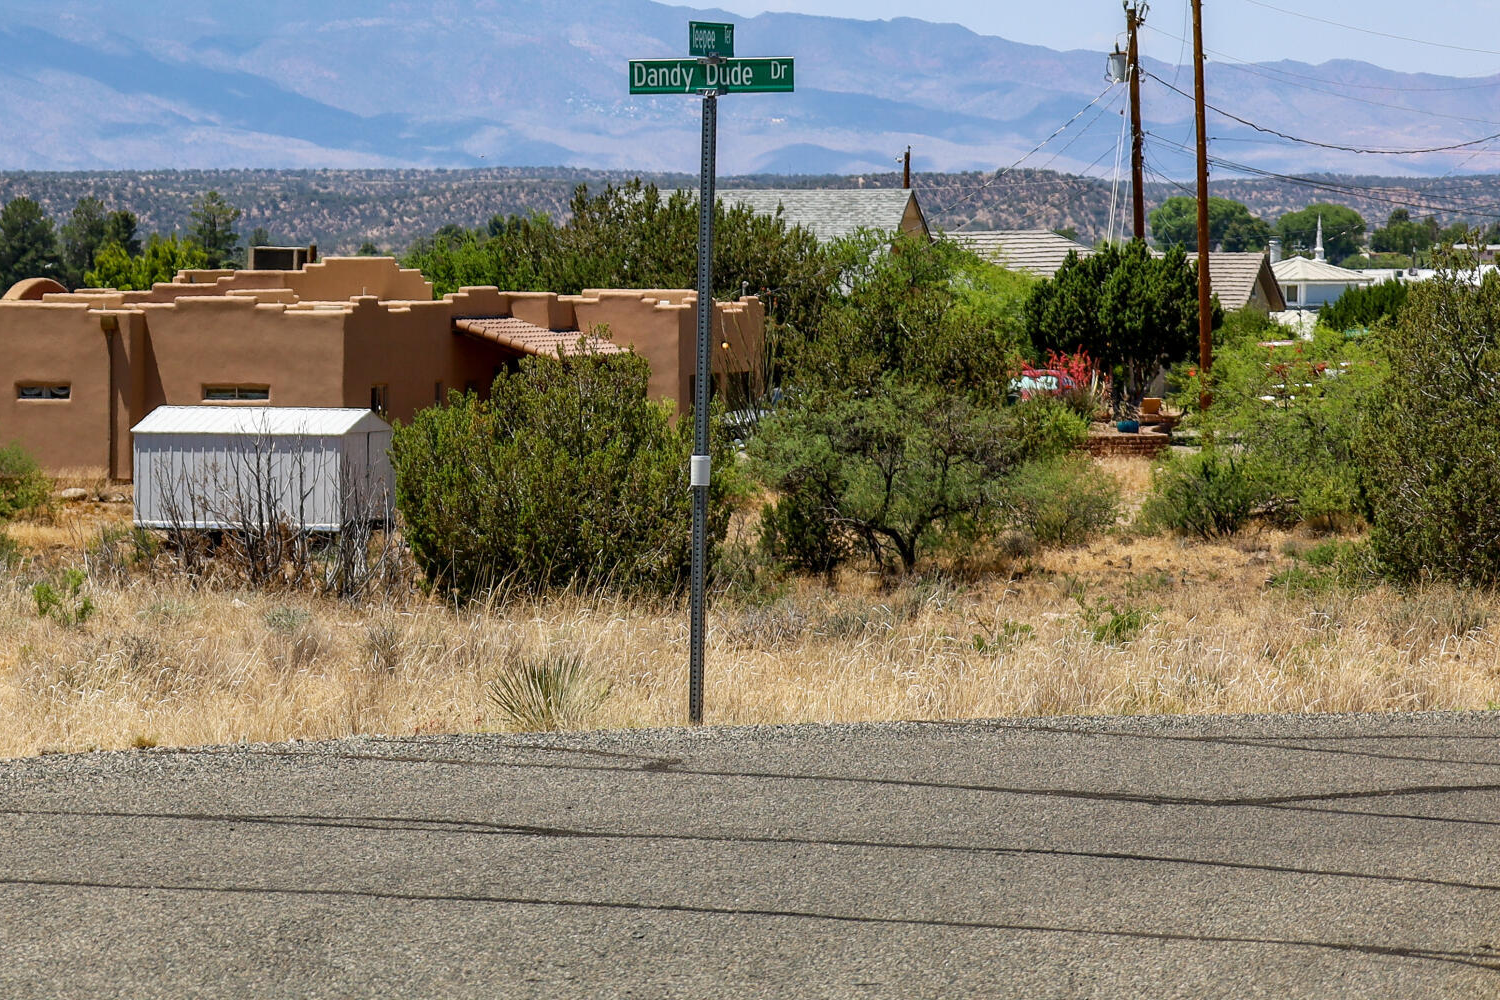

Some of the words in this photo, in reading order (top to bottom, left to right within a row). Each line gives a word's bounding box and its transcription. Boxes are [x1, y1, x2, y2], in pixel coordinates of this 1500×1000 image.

[691, 23, 716, 54] Teepee
[724, 25, 732, 44] Ter
[634, 62, 694, 91] Dandy
[706, 62, 753, 86] Dude
[770, 61, 787, 80] Dr
